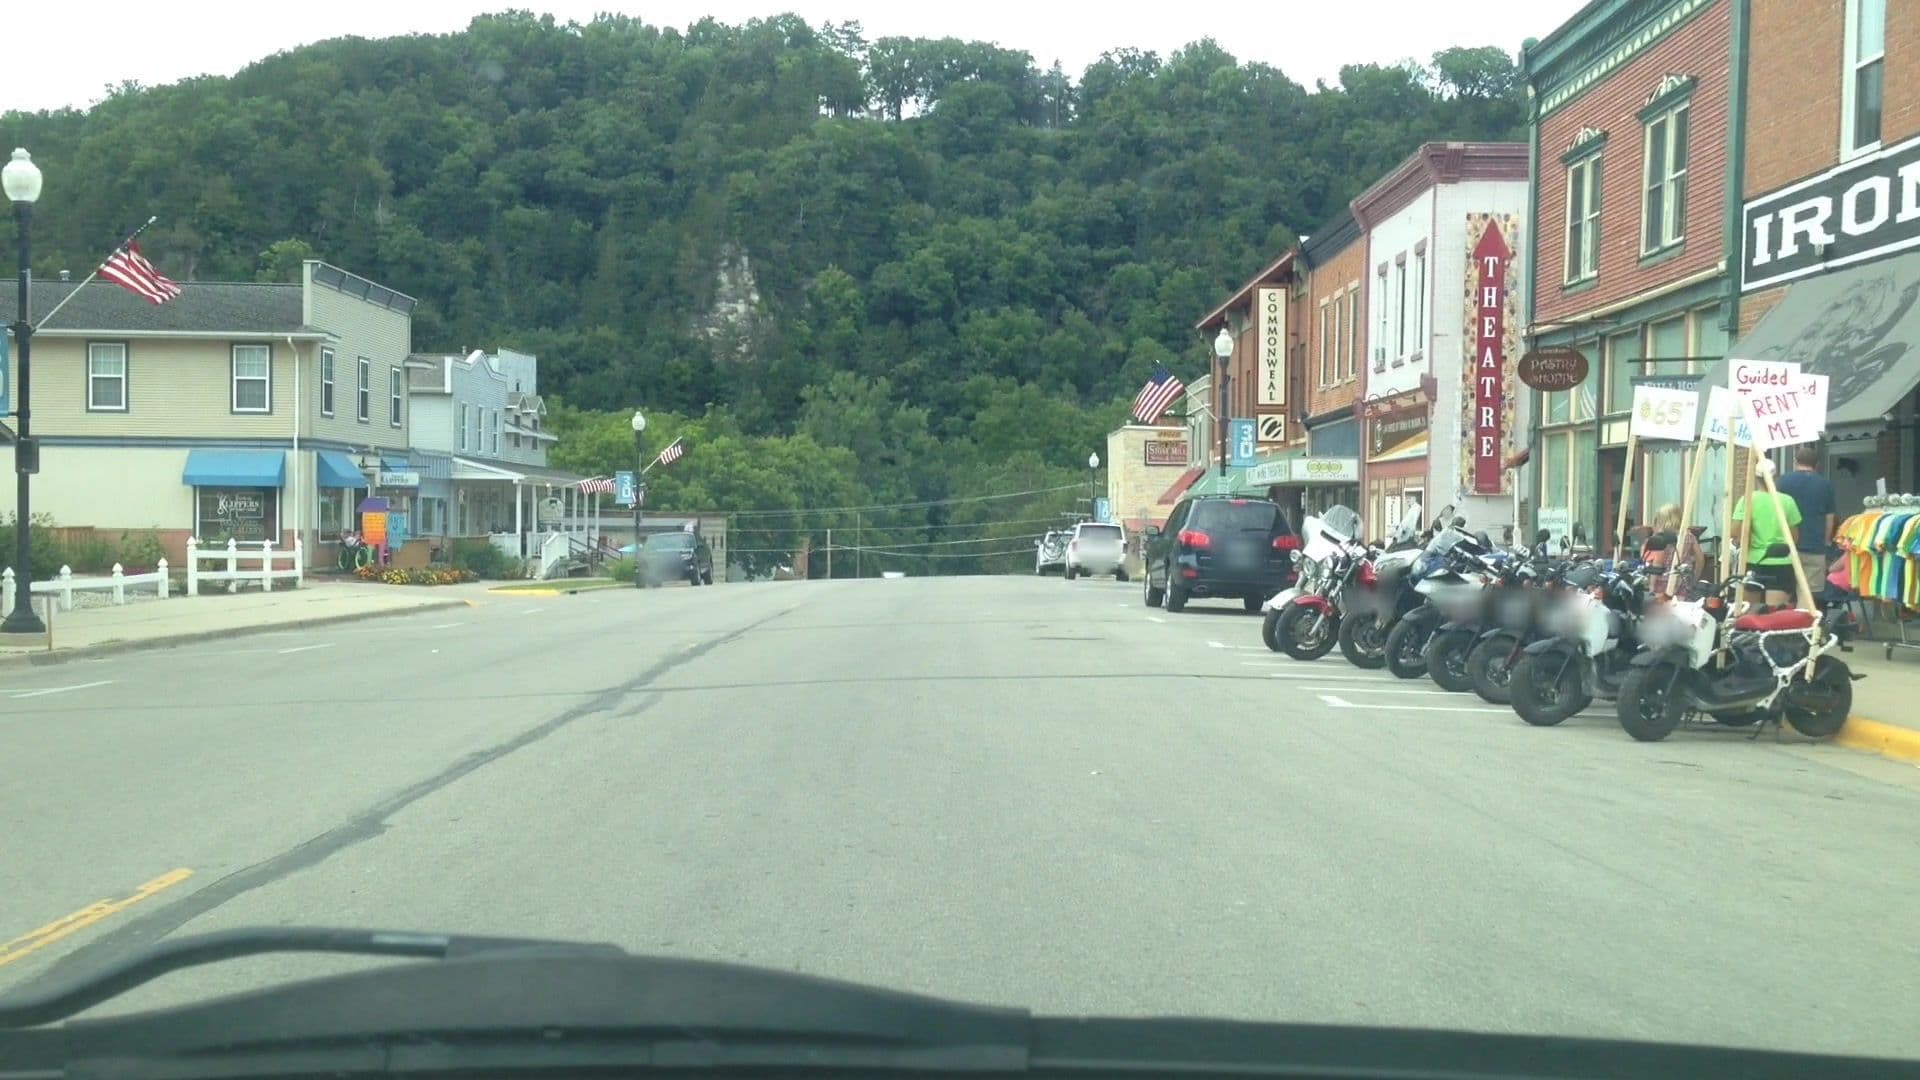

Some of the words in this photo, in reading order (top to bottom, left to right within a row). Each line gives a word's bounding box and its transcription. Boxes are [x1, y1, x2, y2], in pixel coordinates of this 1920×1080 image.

[1266, 292, 1278, 401] COMMONWEAL
[1480, 256, 1499, 457] THEATRE
[1530, 359, 1577, 371] PASTRY
[1736, 365, 1788, 386] Guided
[1752, 391, 1799, 418] RENT
[1768, 419, 1800, 441] ME
